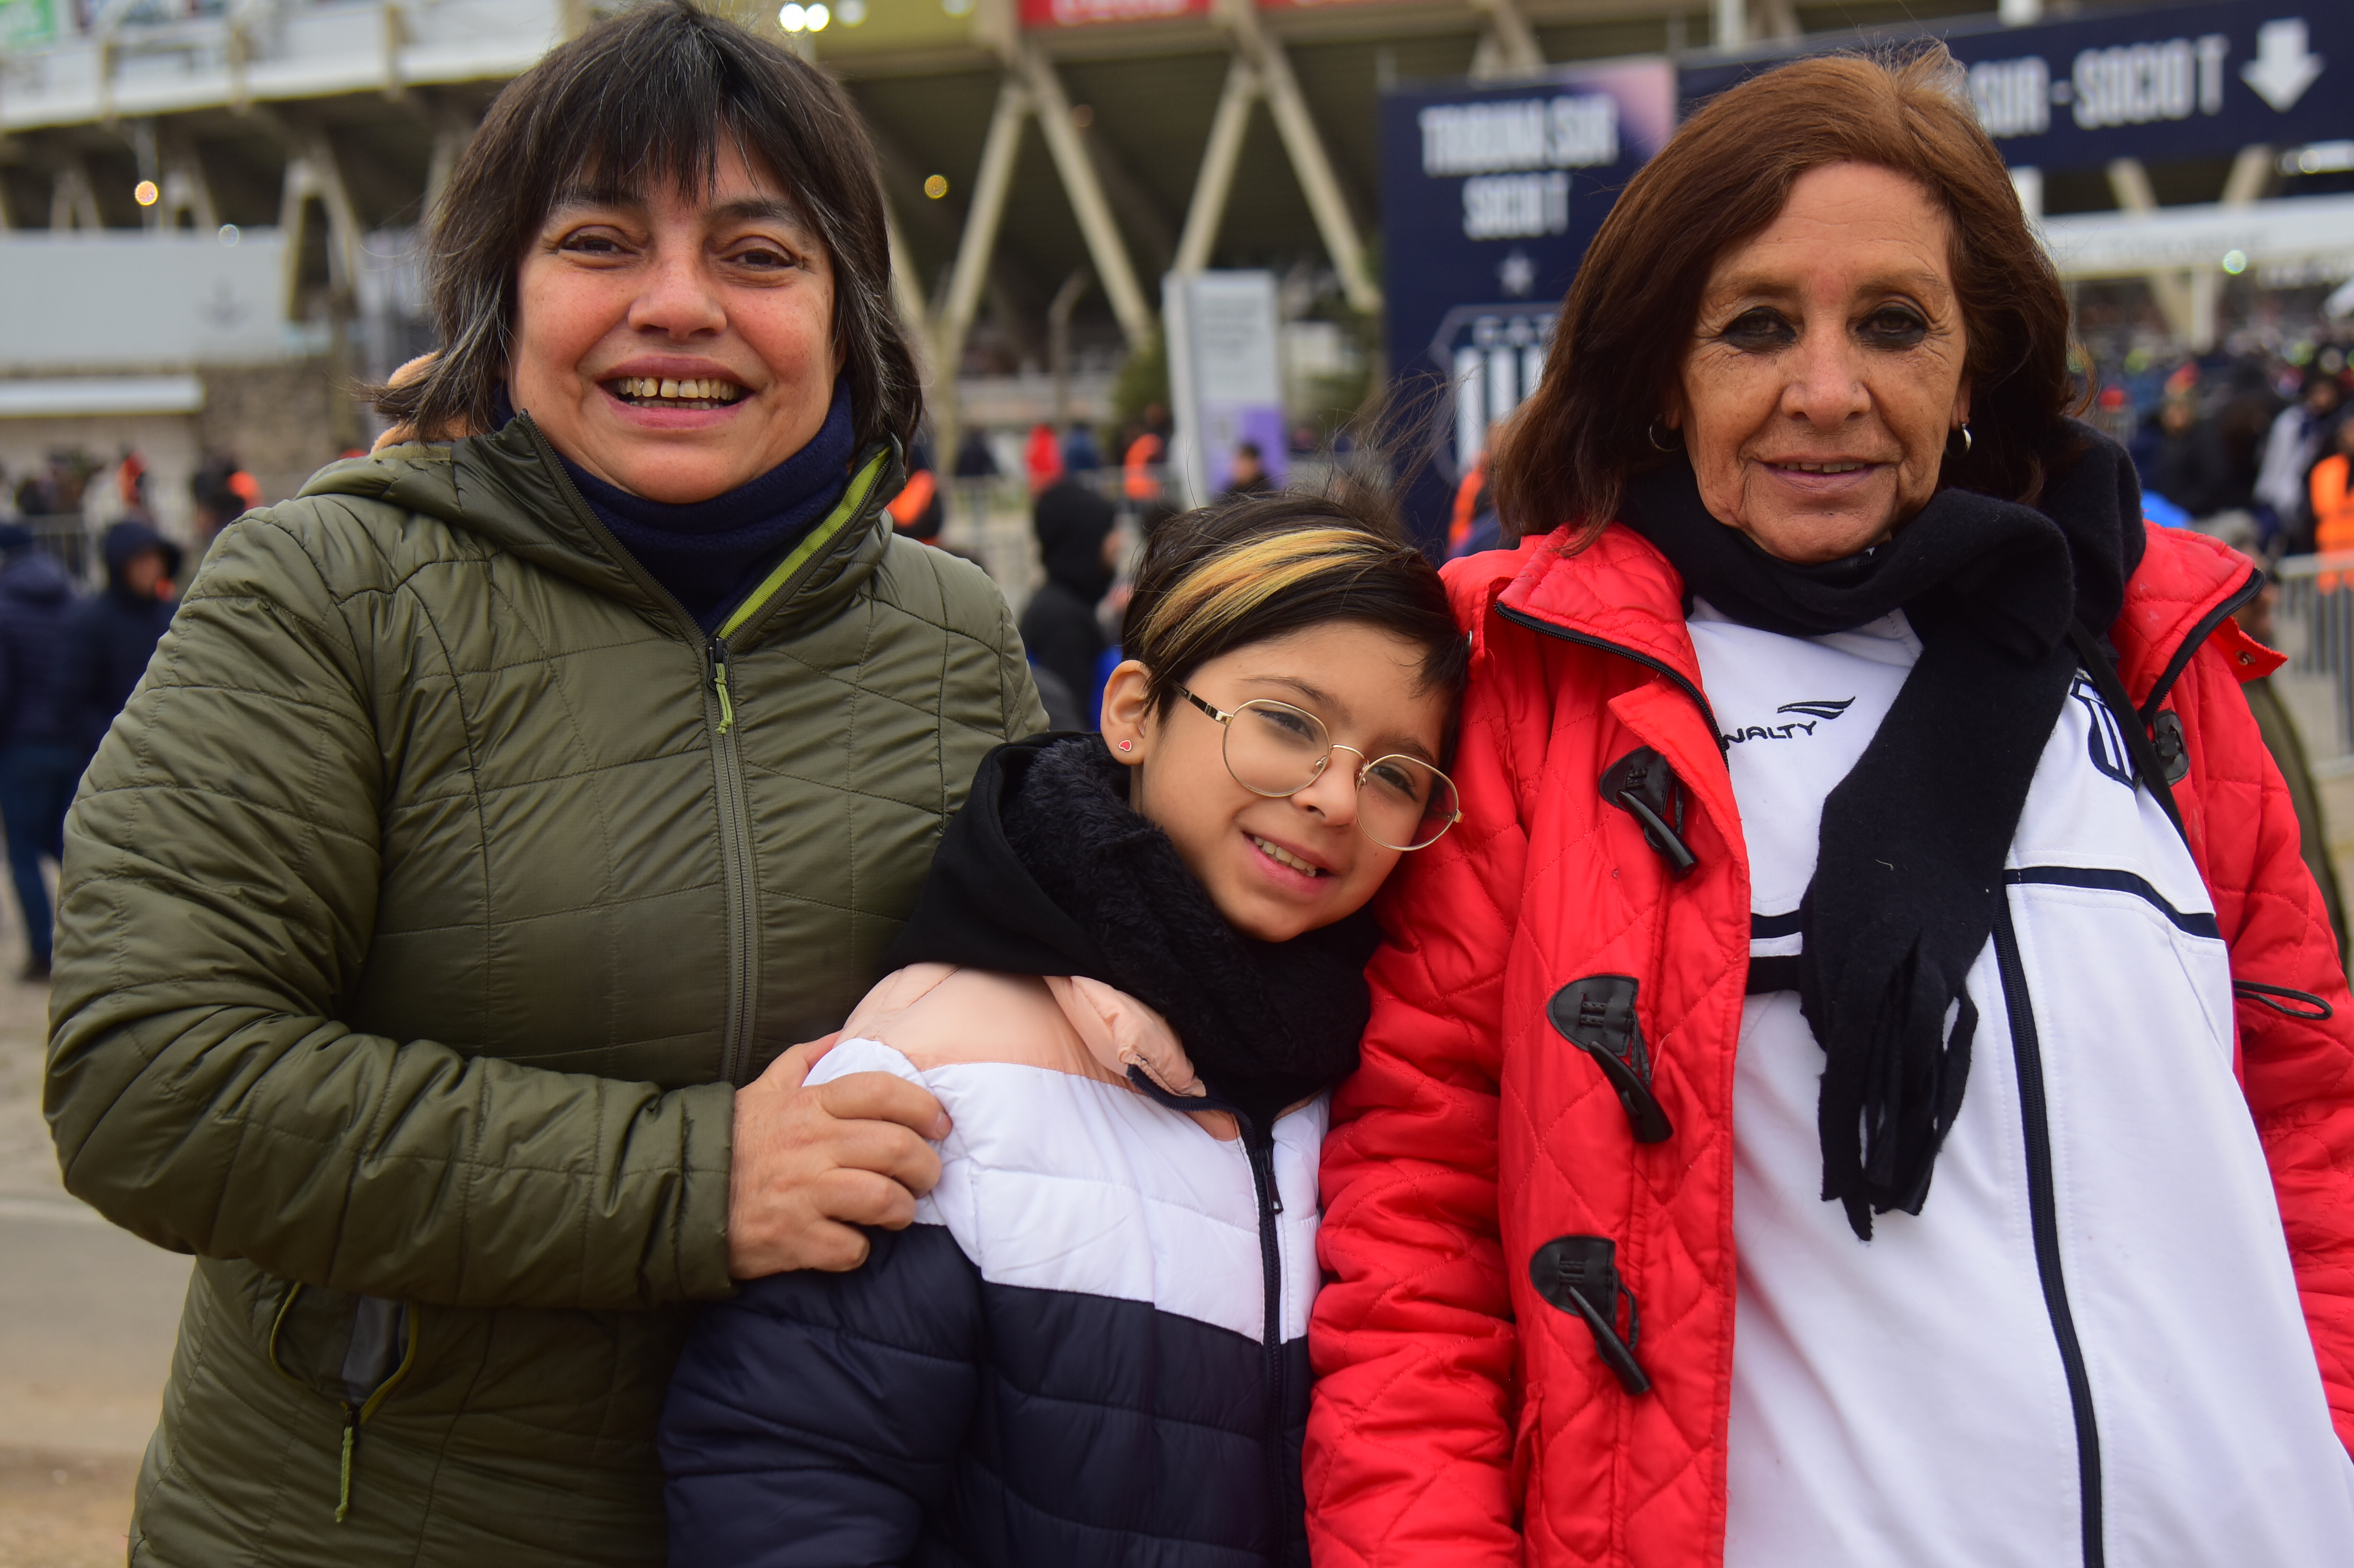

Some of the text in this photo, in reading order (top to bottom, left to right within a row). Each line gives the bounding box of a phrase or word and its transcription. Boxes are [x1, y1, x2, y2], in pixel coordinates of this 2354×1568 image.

[1970, 56, 2050, 137] SUR
[2073, 38, 2195, 129] SOCIO
[2196, 34, 2229, 115] T
[1546, 93, 1618, 166] SUR
[1462, 171, 1571, 239] SOCIO T
